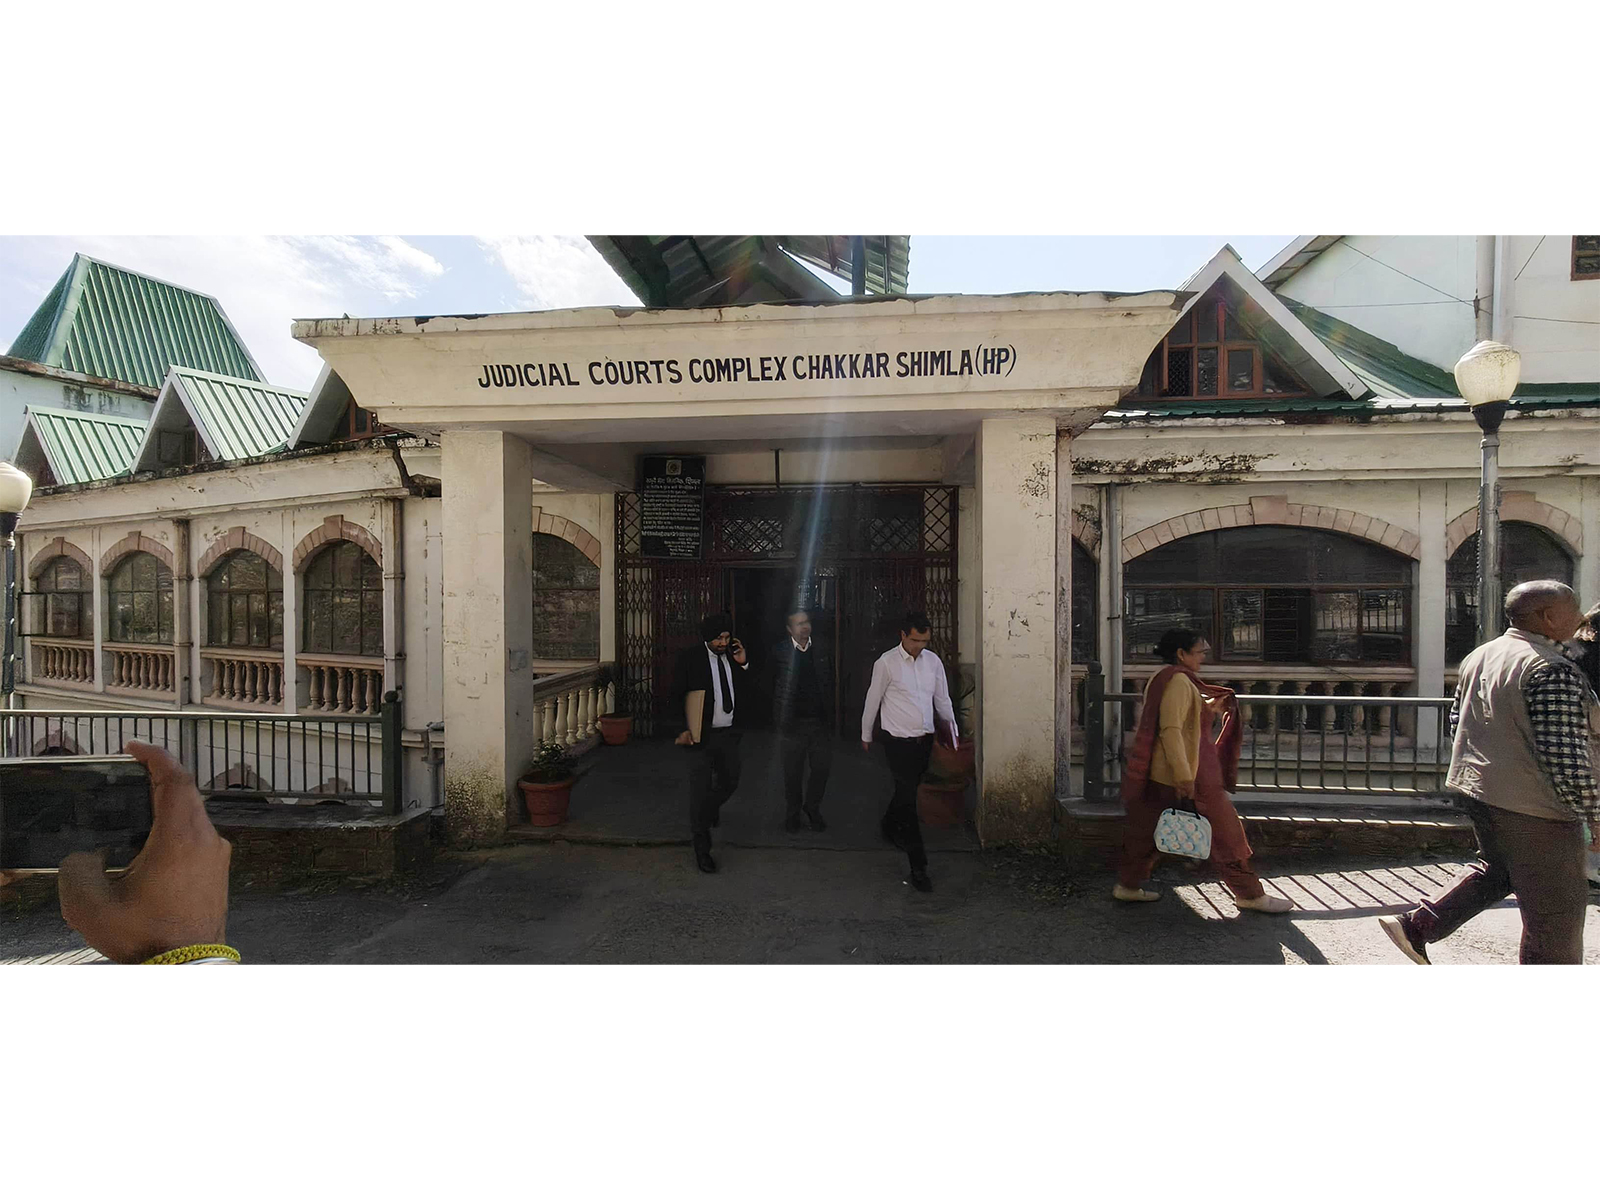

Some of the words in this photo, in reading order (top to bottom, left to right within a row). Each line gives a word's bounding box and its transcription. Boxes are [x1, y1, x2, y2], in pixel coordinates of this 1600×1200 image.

[478, 363, 580, 388] JUDICIAL
[588, 360, 682, 385] COURTS
[688, 357, 788, 383] COMPLEX
[792, 353, 890, 380] CHAKKAR
